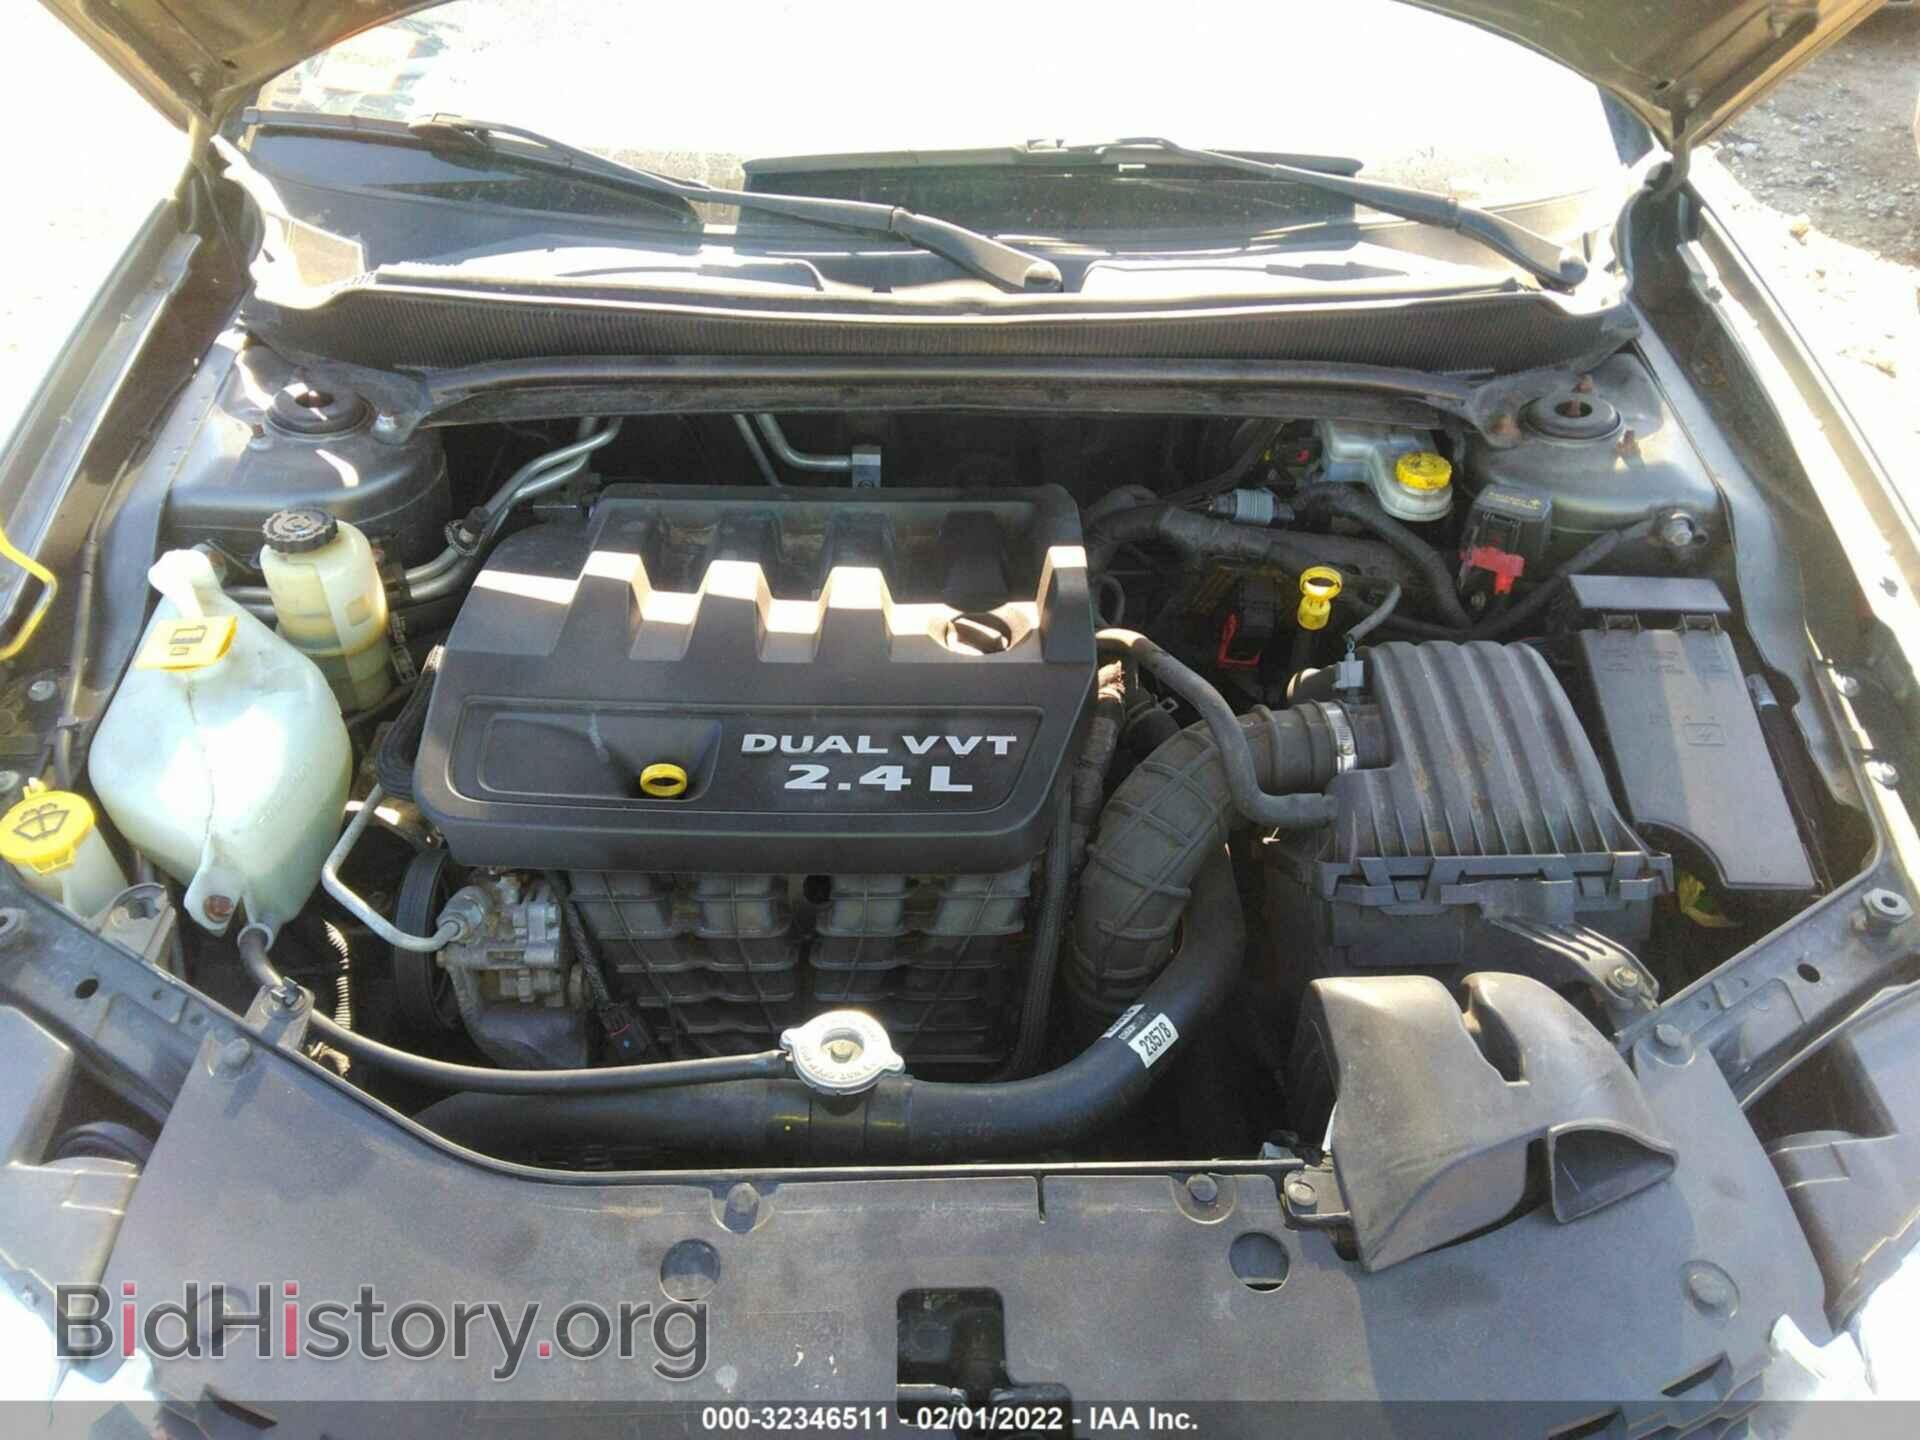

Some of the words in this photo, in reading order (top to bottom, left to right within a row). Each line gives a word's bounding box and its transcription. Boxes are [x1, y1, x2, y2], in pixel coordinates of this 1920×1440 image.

[740, 733, 889, 754] DUAL
[902, 734, 1017, 756] VVT
[1138, 1021, 1172, 1057] 23578
